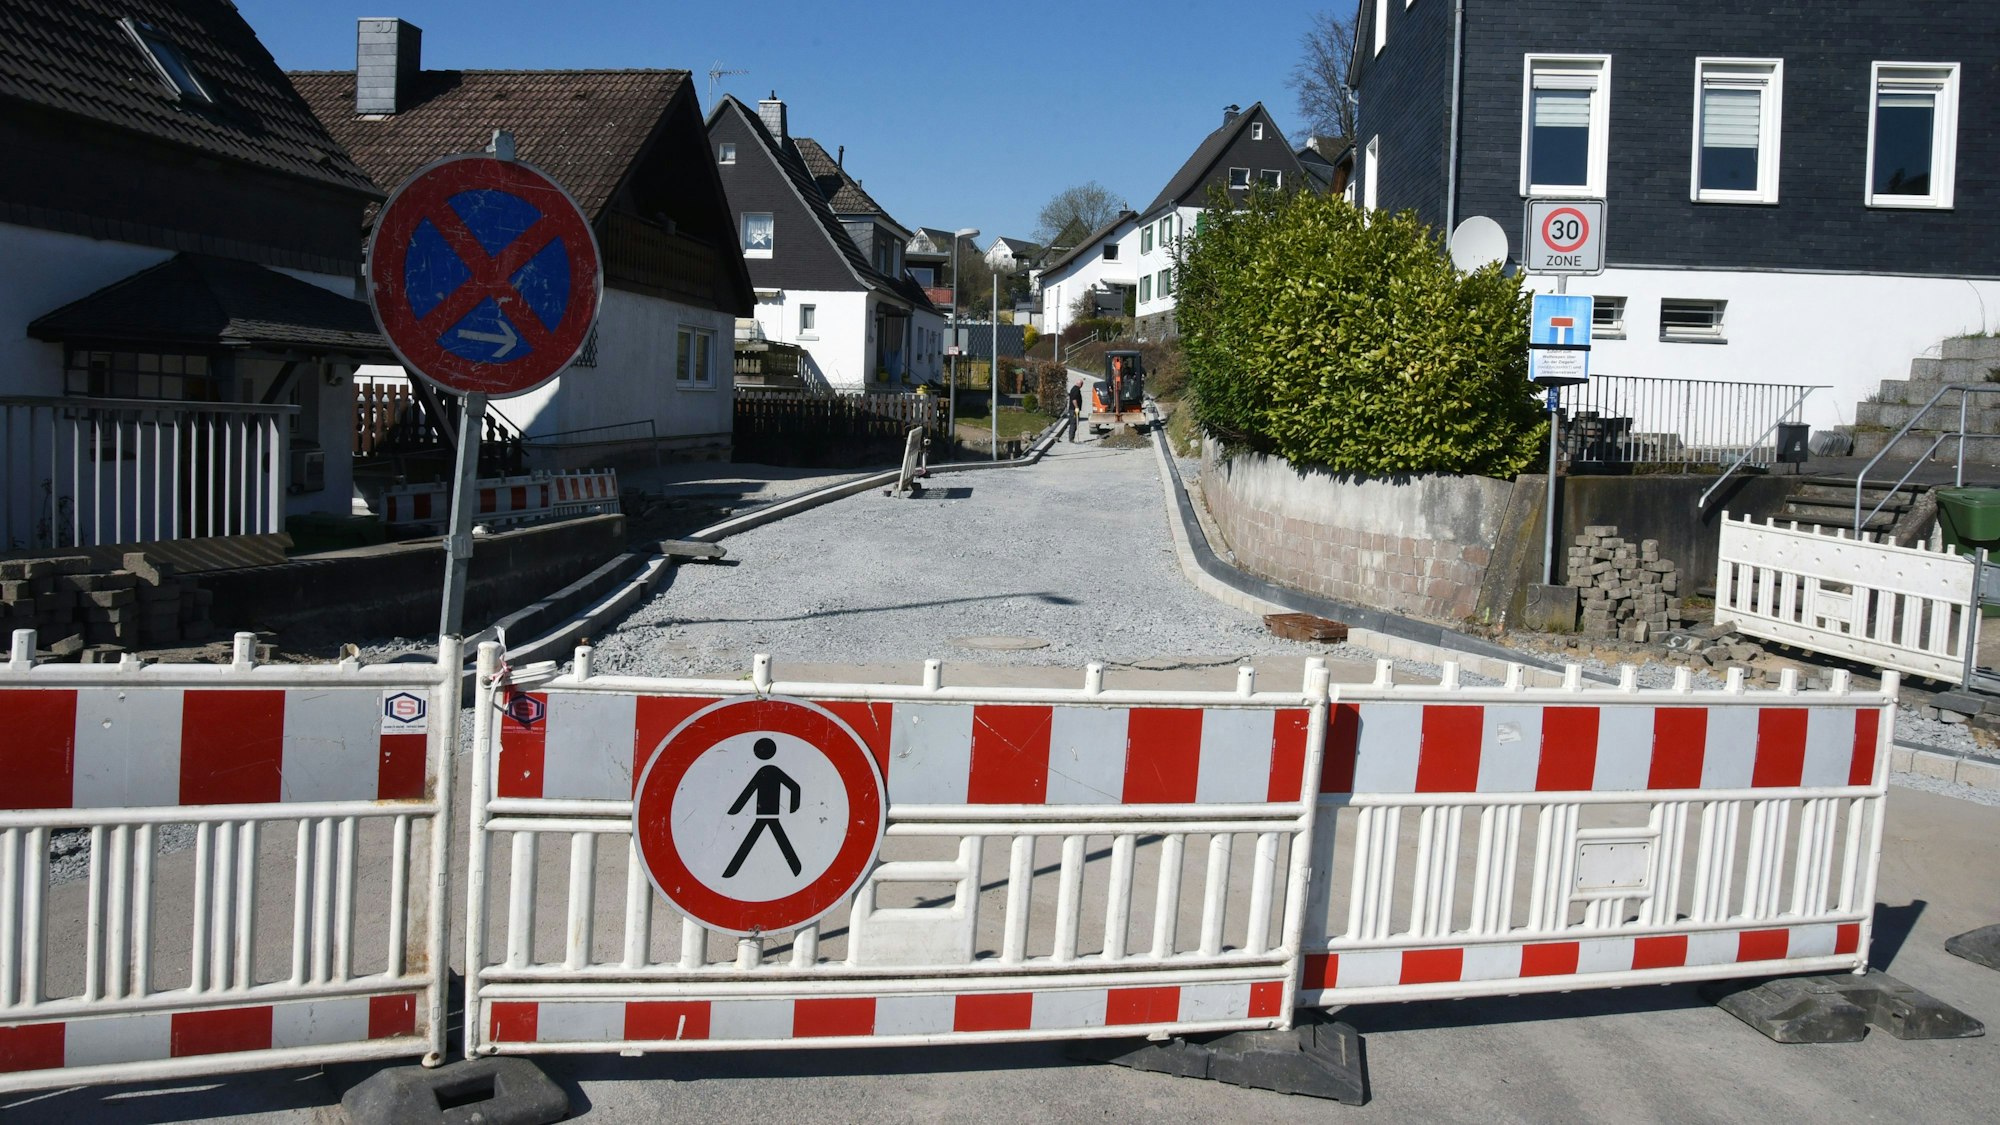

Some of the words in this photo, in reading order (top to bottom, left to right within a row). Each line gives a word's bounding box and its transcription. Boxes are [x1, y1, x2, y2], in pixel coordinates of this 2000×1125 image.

[1552, 220, 1578, 239] 30
[1546, 256, 1581, 266] ZONE
[396, 701, 416, 715] S
